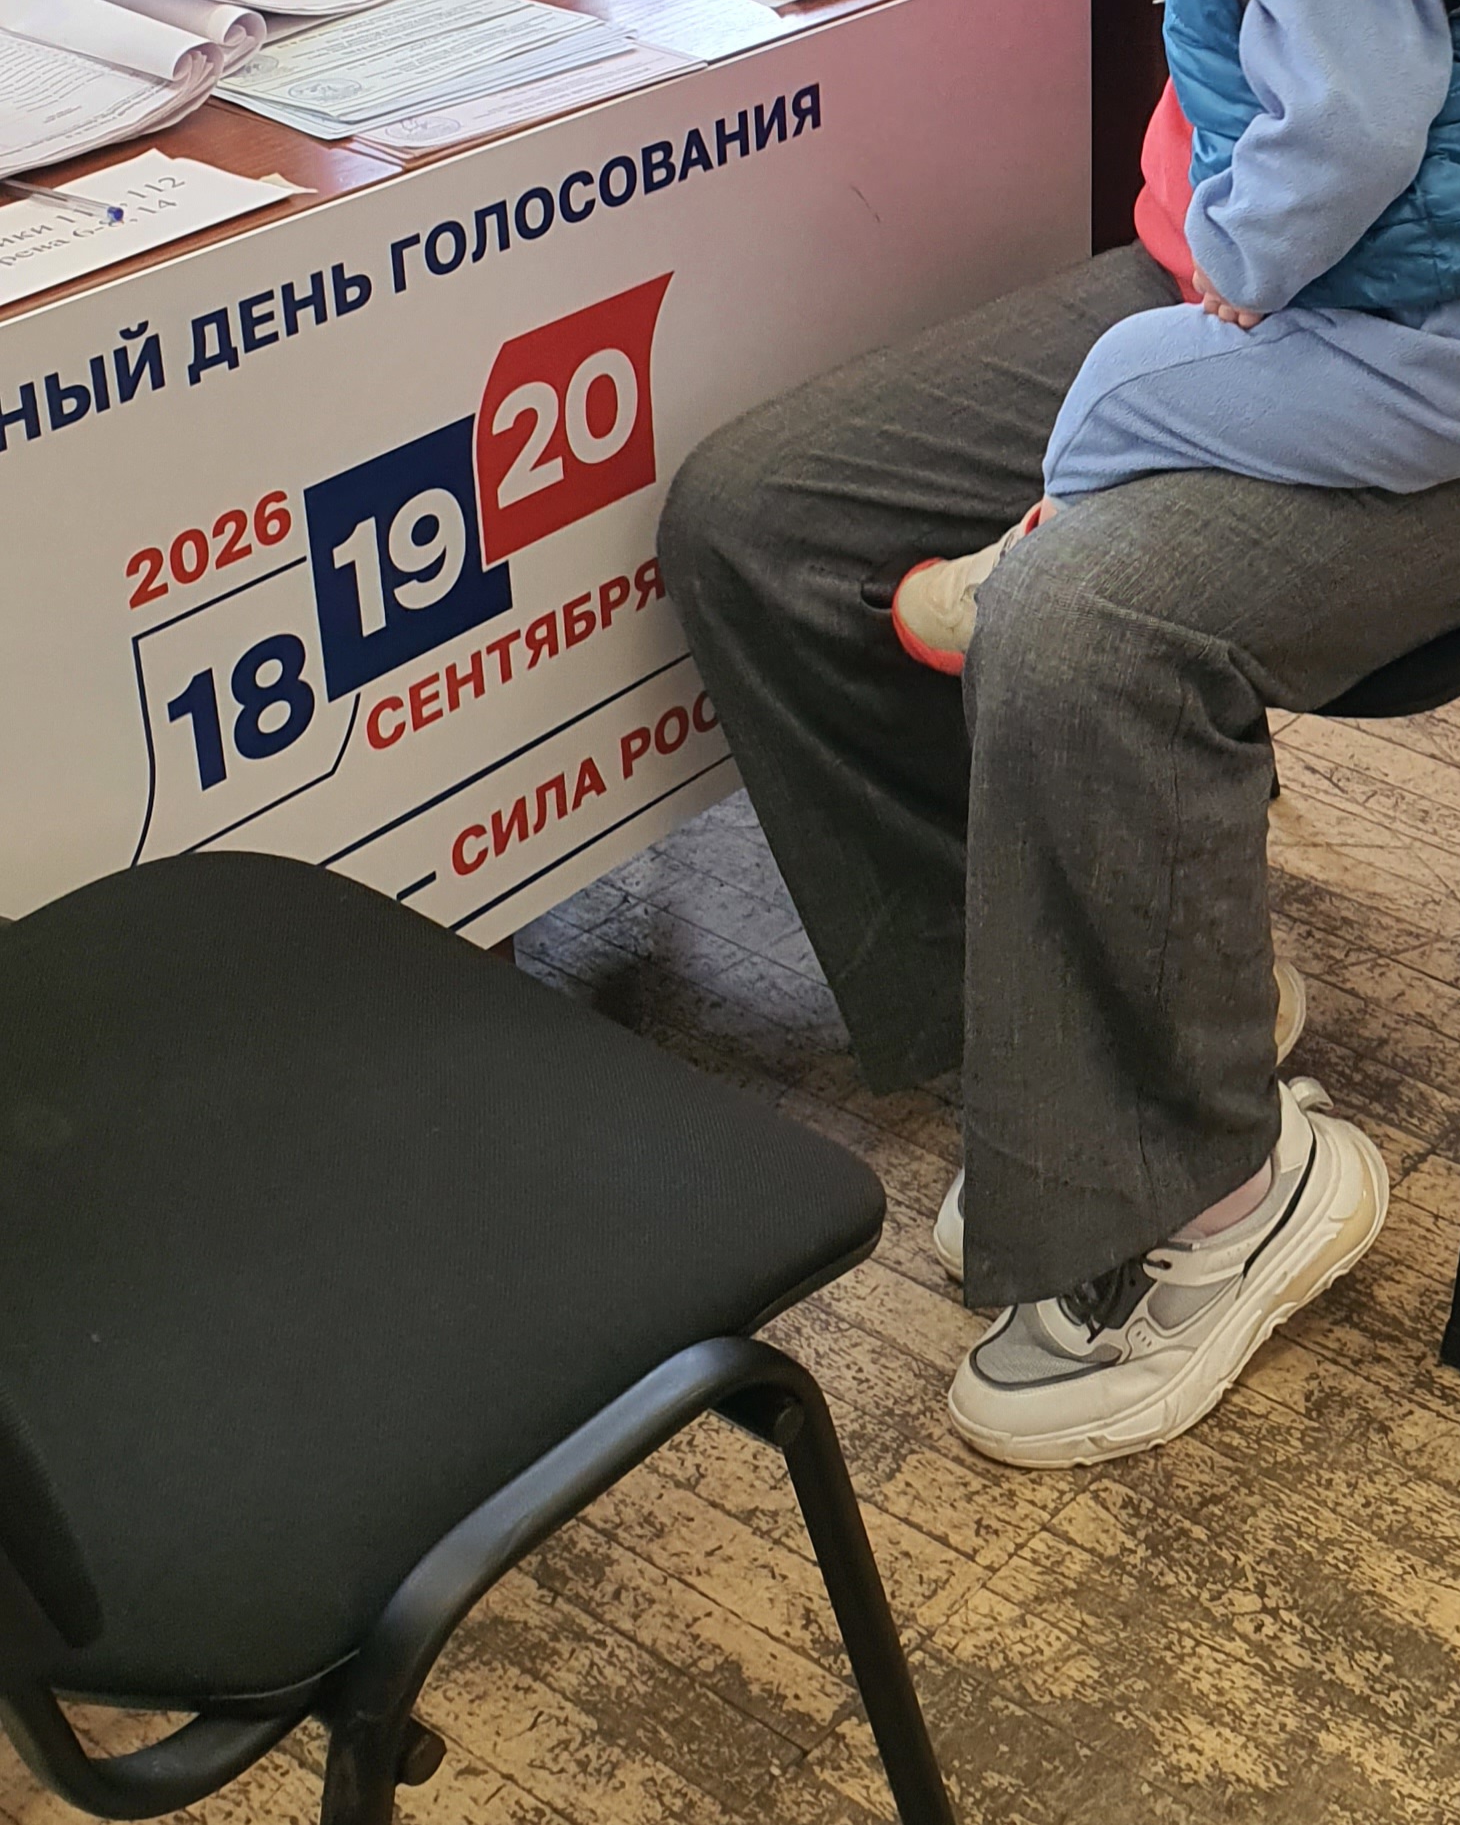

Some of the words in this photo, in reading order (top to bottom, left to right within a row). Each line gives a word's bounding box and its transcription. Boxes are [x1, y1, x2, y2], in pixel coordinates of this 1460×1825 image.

[127, 177, 186, 199] 112
[137, 199, 177, 214] 14
[0, 319, 166, 453] НЫЙ
[187, 262, 372, 386] ДЕНЬ
[390, 83, 822, 294] ГОЛОСОВАНИЯ
[490, 346, 639, 511] 20
[125, 490, 292, 610] 2026
[332, 487, 467, 638] 19
[168, 633, 316, 791] 18
[366, 556, 666, 750] СЕНТЯБРЯ
[450, 757, 607, 877] СИЛА
